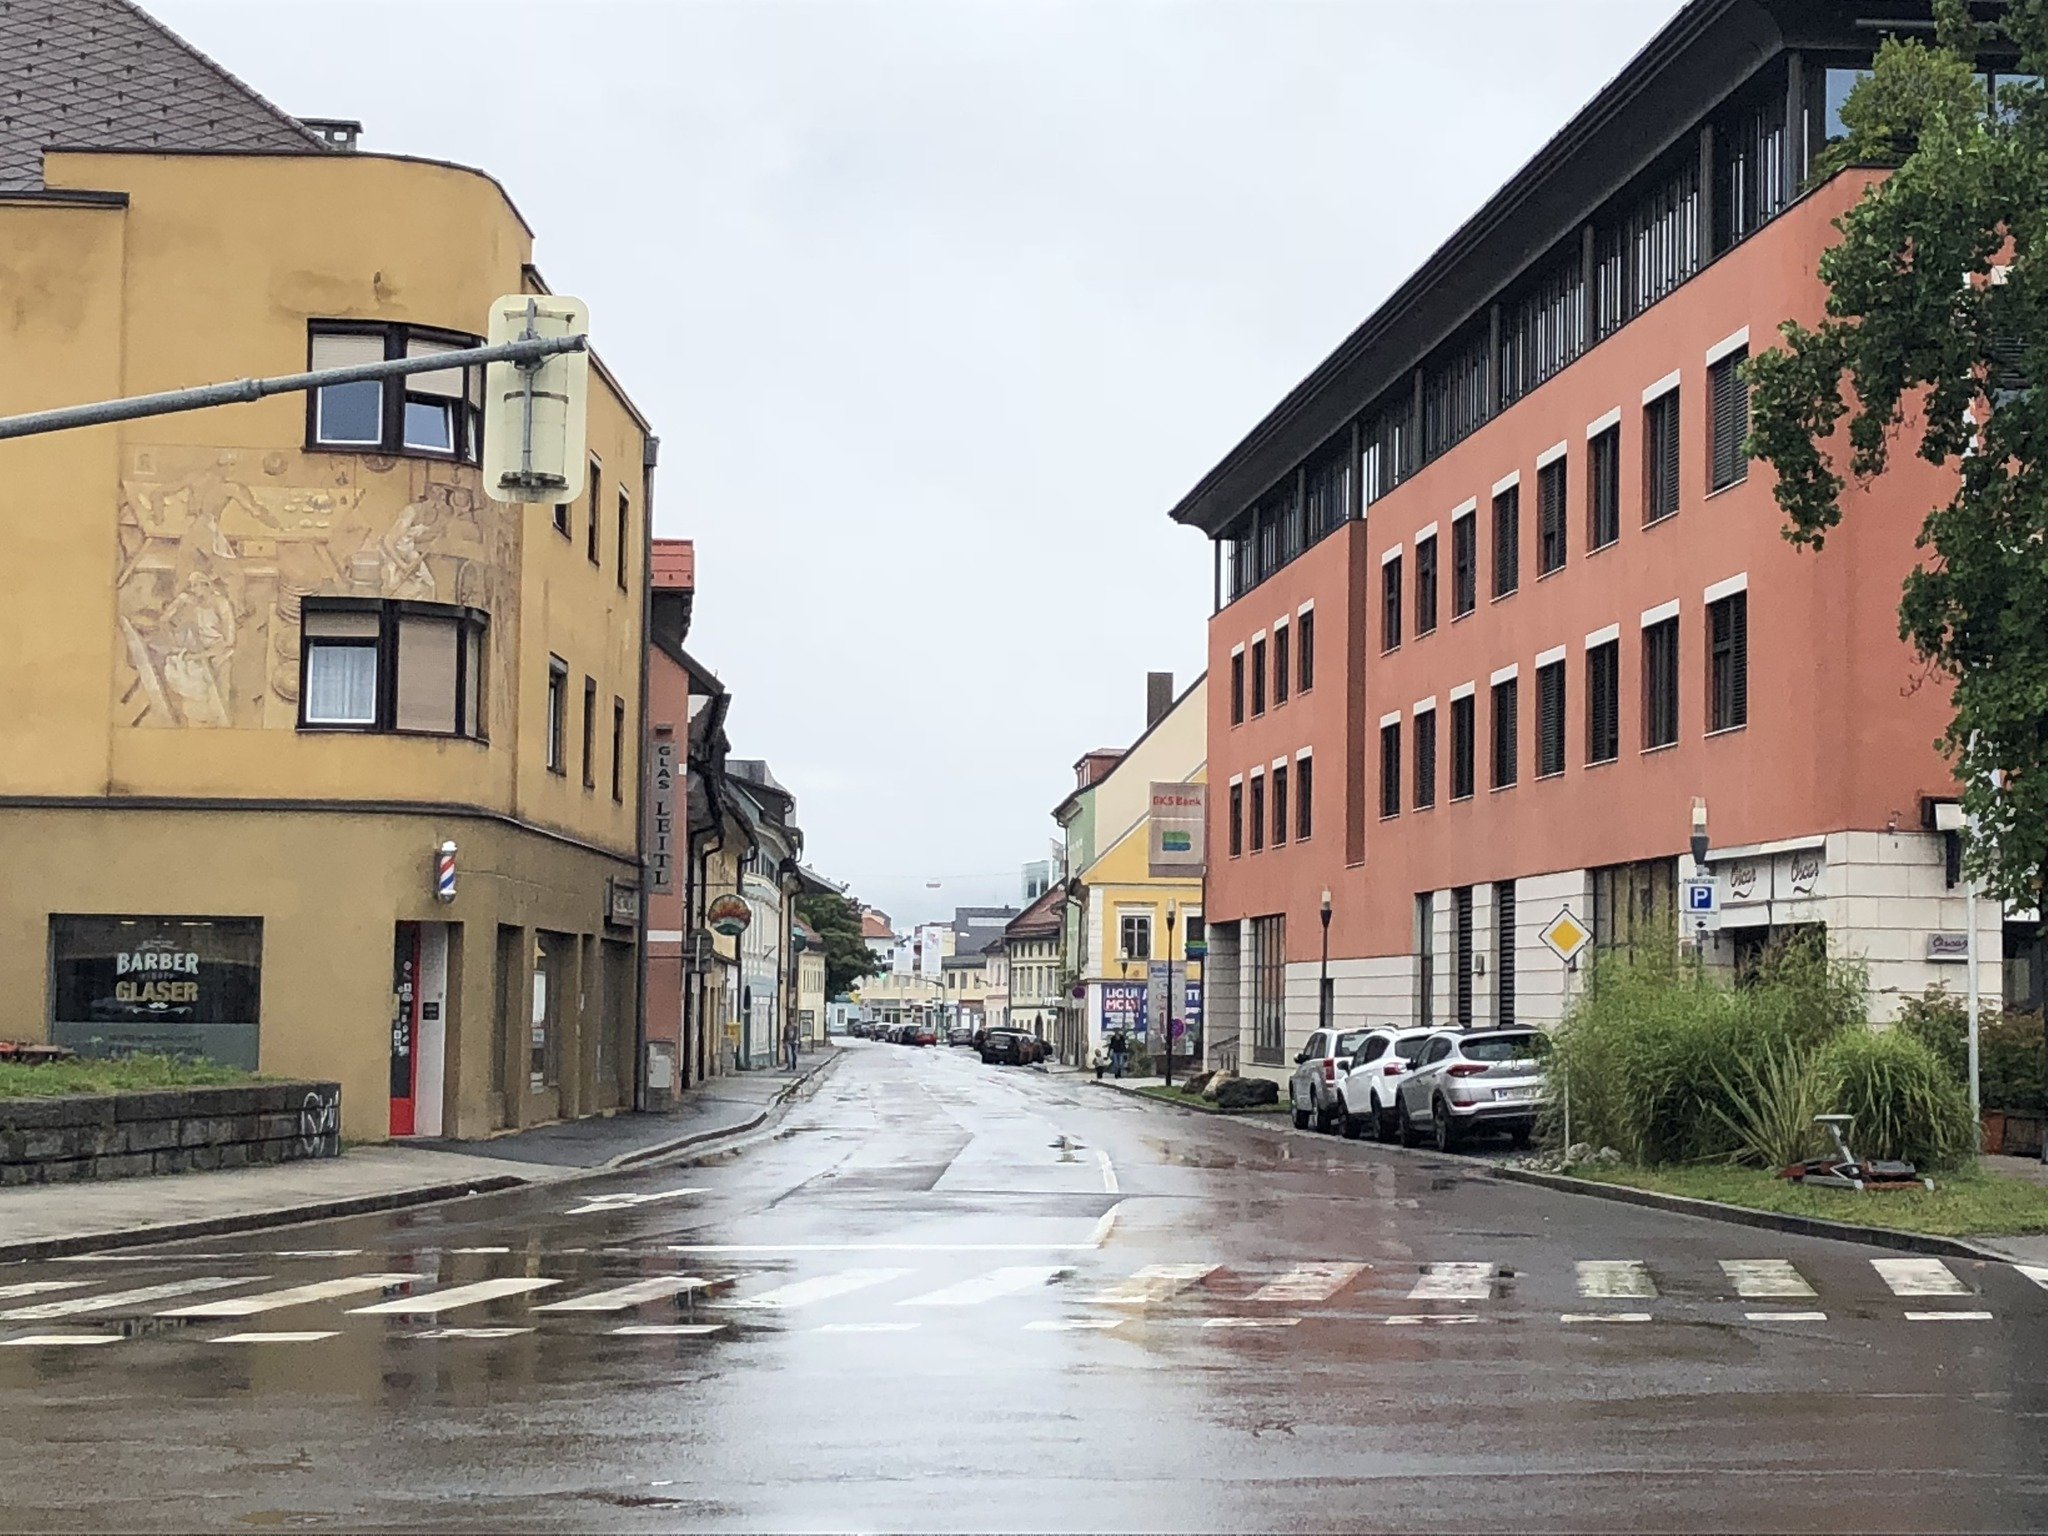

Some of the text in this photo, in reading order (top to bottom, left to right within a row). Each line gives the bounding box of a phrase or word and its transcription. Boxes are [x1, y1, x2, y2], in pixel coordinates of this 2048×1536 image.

[1153, 796, 1201, 806] BKS Bank
[653, 745, 672, 886] GLAS LEITL
[1693, 888, 1709, 908] P
[116, 952, 199, 975] BARBER
[115, 981, 199, 1001] GLASER
